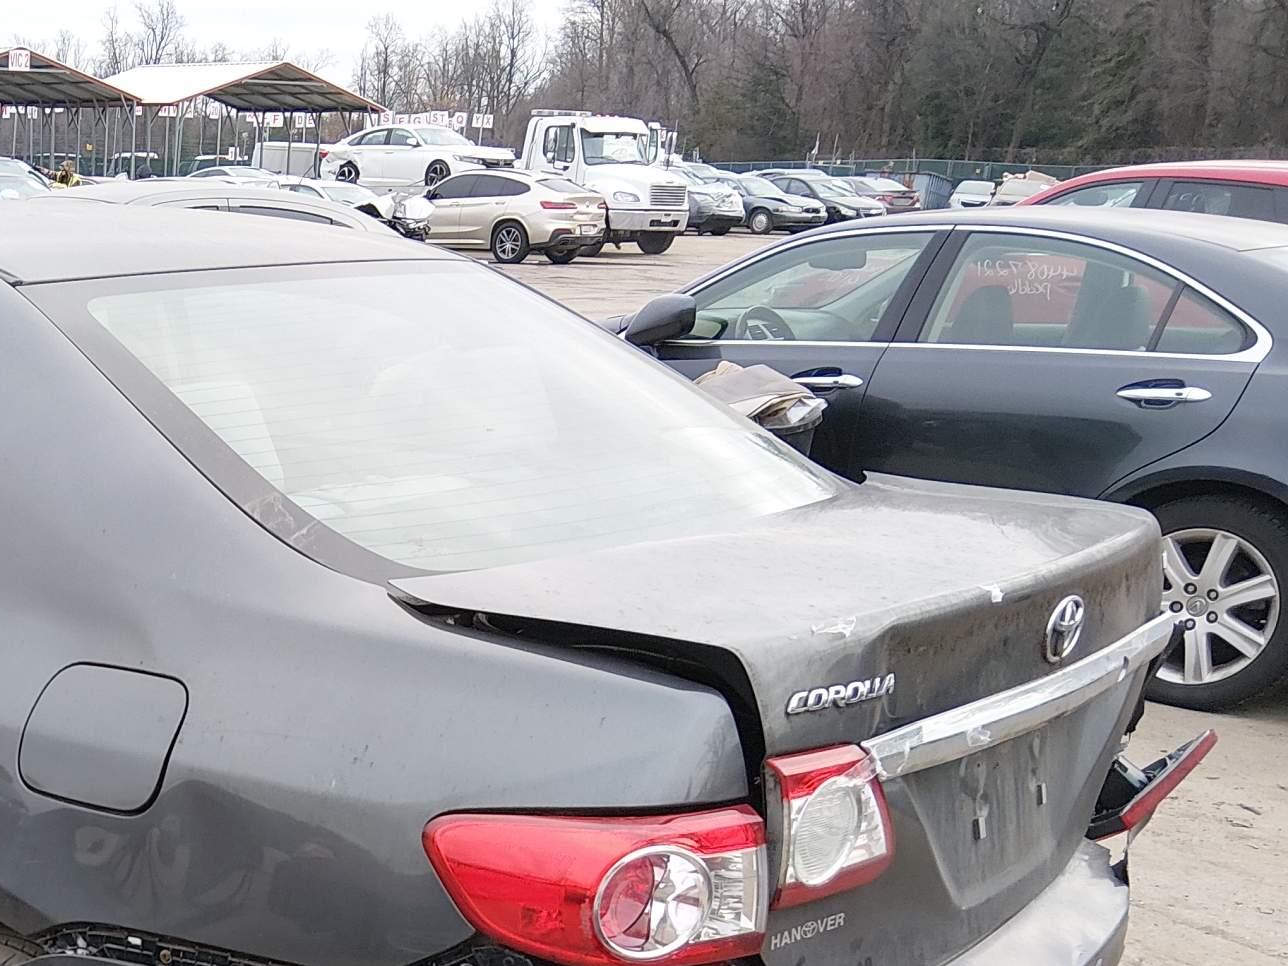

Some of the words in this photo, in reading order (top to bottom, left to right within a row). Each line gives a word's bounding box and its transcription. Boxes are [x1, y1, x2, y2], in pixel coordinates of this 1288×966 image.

[10, 52, 23, 68] VIC
[24, 53, 30, 68] 2
[382, 113, 390, 123] S
[786, 672, 896, 714] COROLLA
[770, 912, 845, 951] HANOVER
